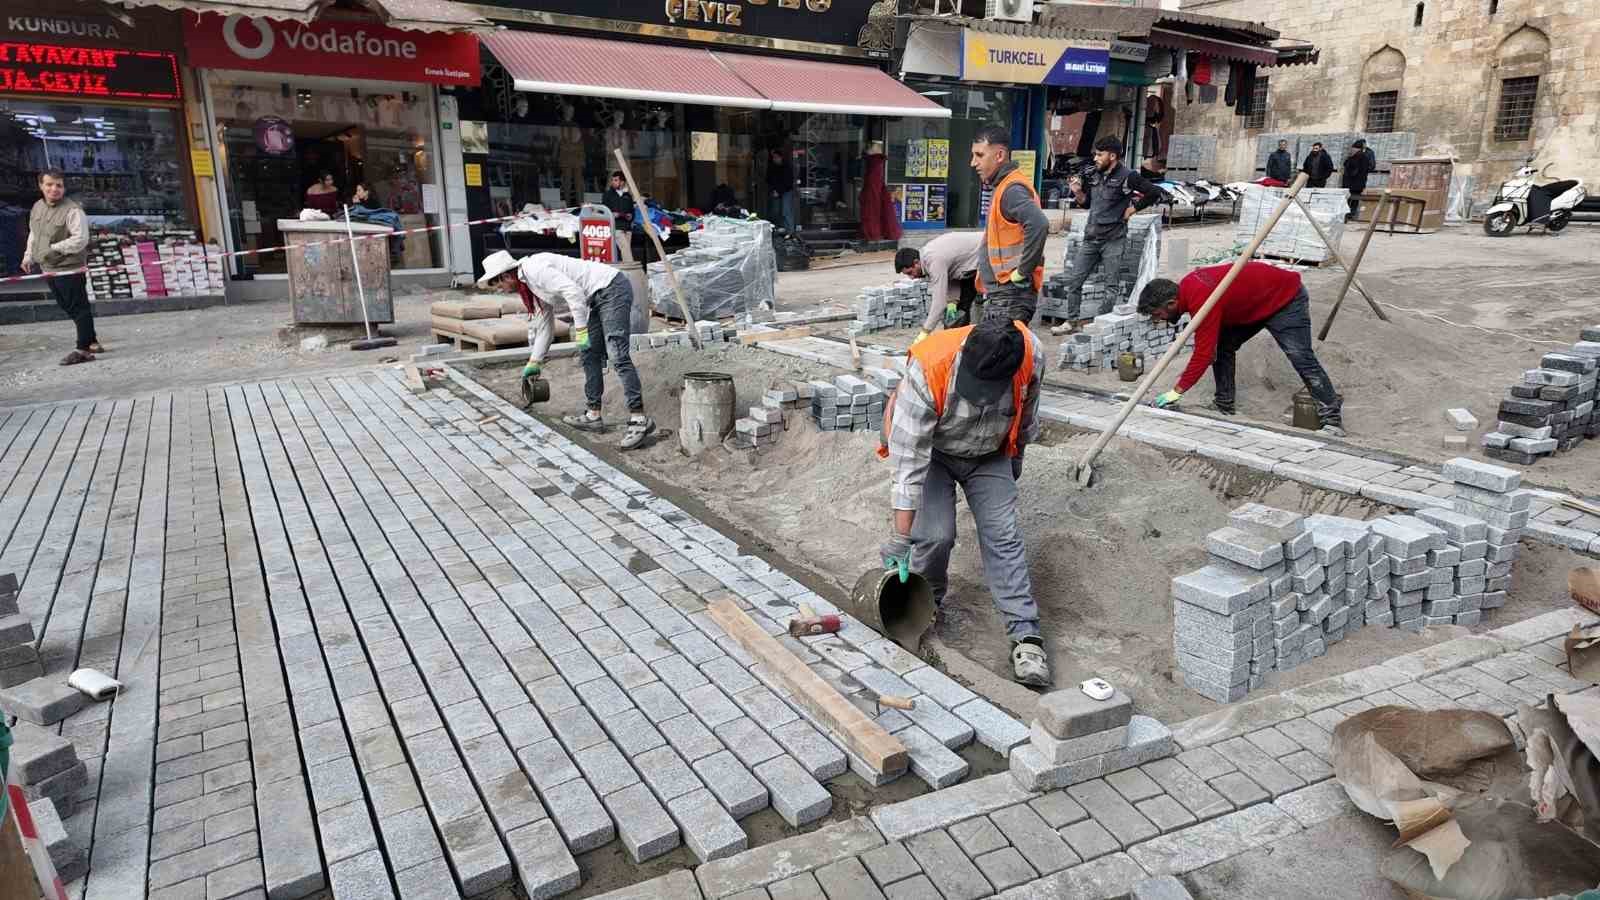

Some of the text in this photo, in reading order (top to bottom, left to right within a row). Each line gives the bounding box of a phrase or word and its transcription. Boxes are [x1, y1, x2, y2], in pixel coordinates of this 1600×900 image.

[7, 16, 120, 39] KUNDURA
[281, 25, 417, 59] vodafone
[988, 48, 1047, 67] TURKCELL
[582, 224, 611, 239] 40GB
